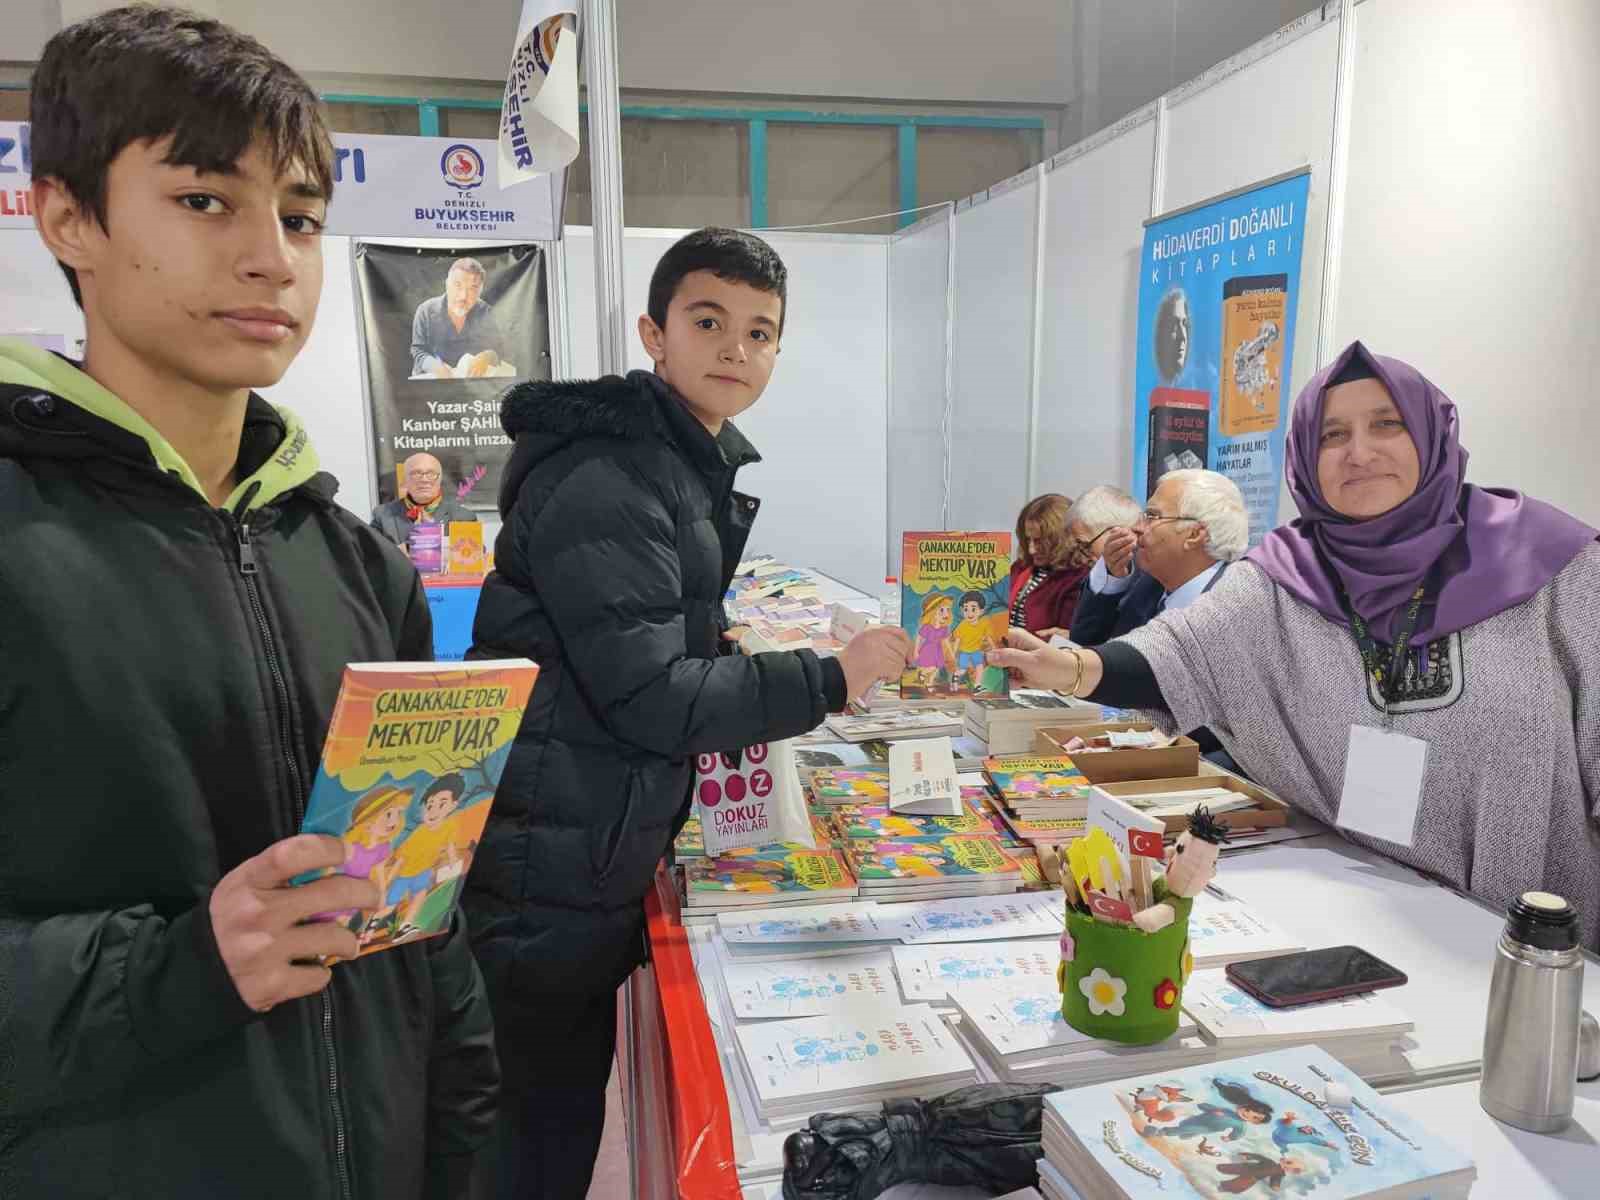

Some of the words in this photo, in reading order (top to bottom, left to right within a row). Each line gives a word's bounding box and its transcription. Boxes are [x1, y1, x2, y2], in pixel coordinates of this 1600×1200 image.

[1229, 202, 1294, 241] DOĞANLI
[402, 418, 457, 432] Kanber
[460, 414, 502, 433] ŞAHİ
[394, 436, 470, 451] Kitaplarını
[919, 558, 965, 572] MEKTUP
[966, 559, 997, 579] VAR
[375, 687, 509, 718] ÇANAKKALE'DEN
[367, 718, 453, 749] MEKTUP
[451, 716, 500, 752] VAR
[714, 802, 768, 826] DOKUZ
[714, 818, 769, 837] YAYINLARI
